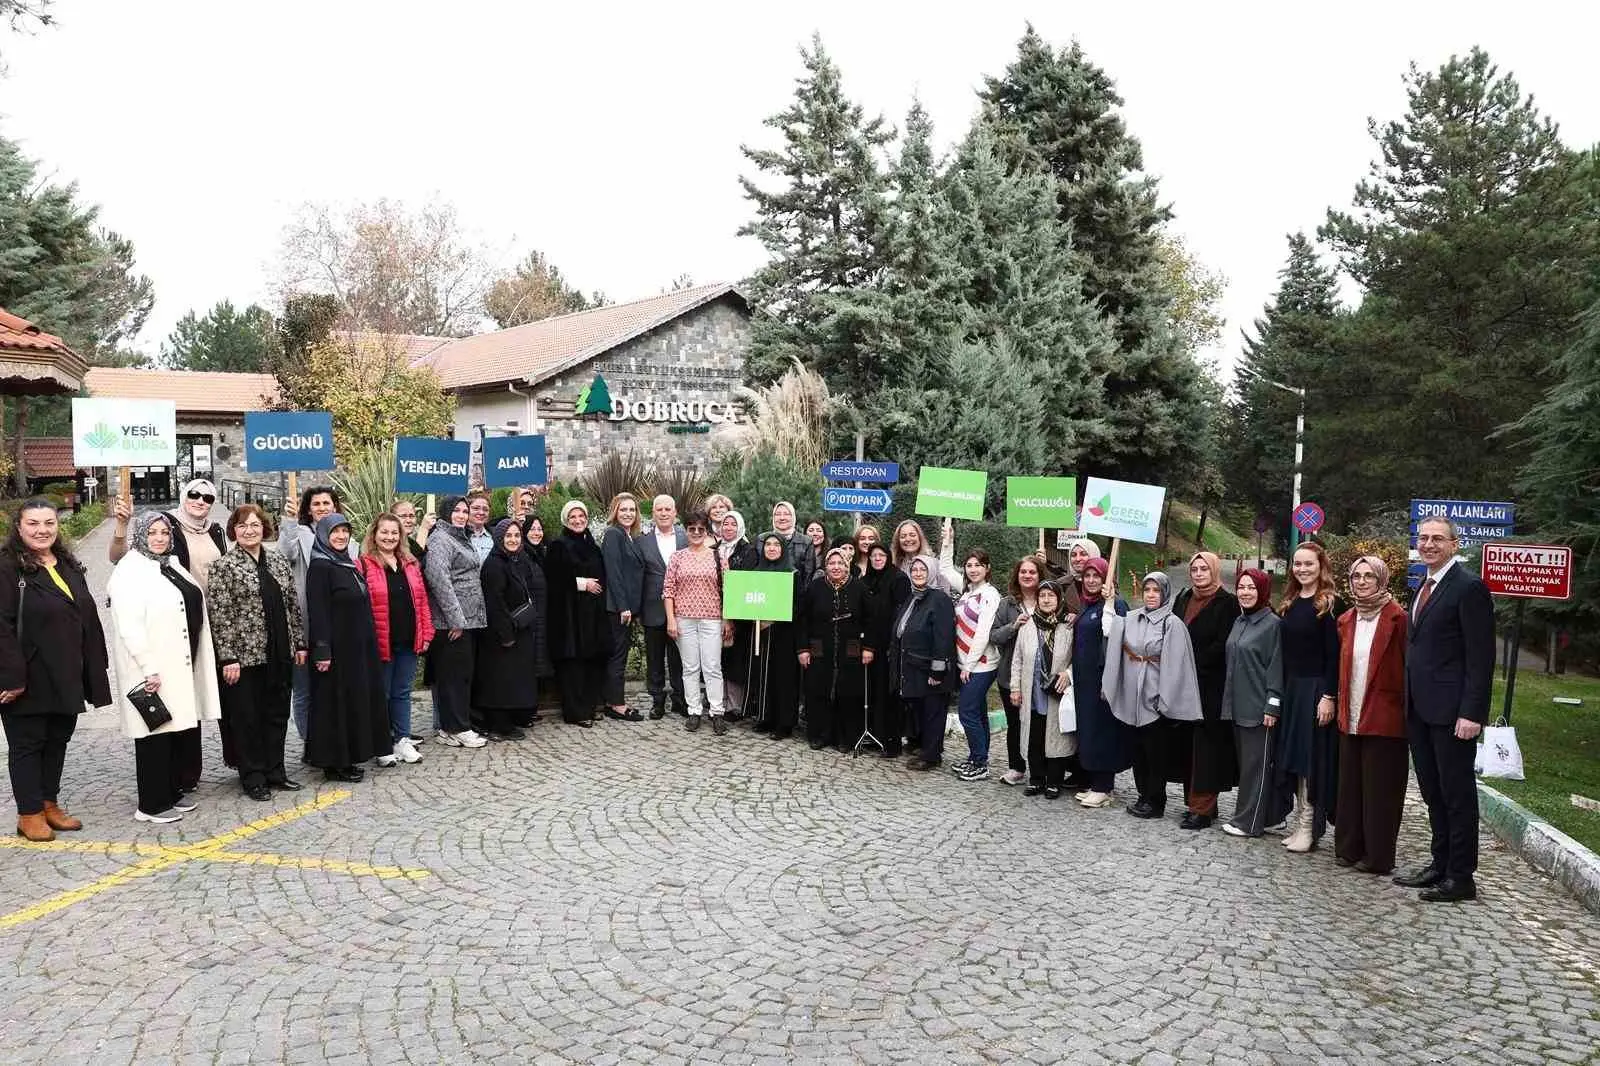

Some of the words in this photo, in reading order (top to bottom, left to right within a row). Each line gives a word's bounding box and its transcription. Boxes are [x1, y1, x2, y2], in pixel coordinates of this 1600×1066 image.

[608, 399, 738, 423] DOBRUCA
[121, 423, 160, 438] YEŞİL
[122, 439, 169, 450] BURSA
[252, 433, 324, 451] GÜCÜNÜ
[400, 459, 467, 476] YERELDEN
[498, 456, 529, 470] ALAN
[830, 466, 888, 477] RESTORAN
[839, 494, 884, 507] OTOPARK
[1013, 496, 1072, 508] YOLCULUĞU
[1111, 506, 1150, 521] GREEN
[1418, 503, 1448, 518] SPOR
[1451, 505, 1506, 520] ALANLARI
[1471, 528, 1505, 537] SAHASI
[1488, 547, 1544, 565] DİKKAT
[1548, 554, 1566, 566] !!!
[1487, 564, 1515, 573] PİKNİK
[1515, 566, 1552, 576] YAPMAK
[1553, 568, 1565, 576] VE
[1490, 573, 1524, 583] MANGAL
[1525, 576, 1561, 585] YAKMAK
[1503, 584, 1545, 594] YASAKTIR
[744, 590, 767, 605] BİR
